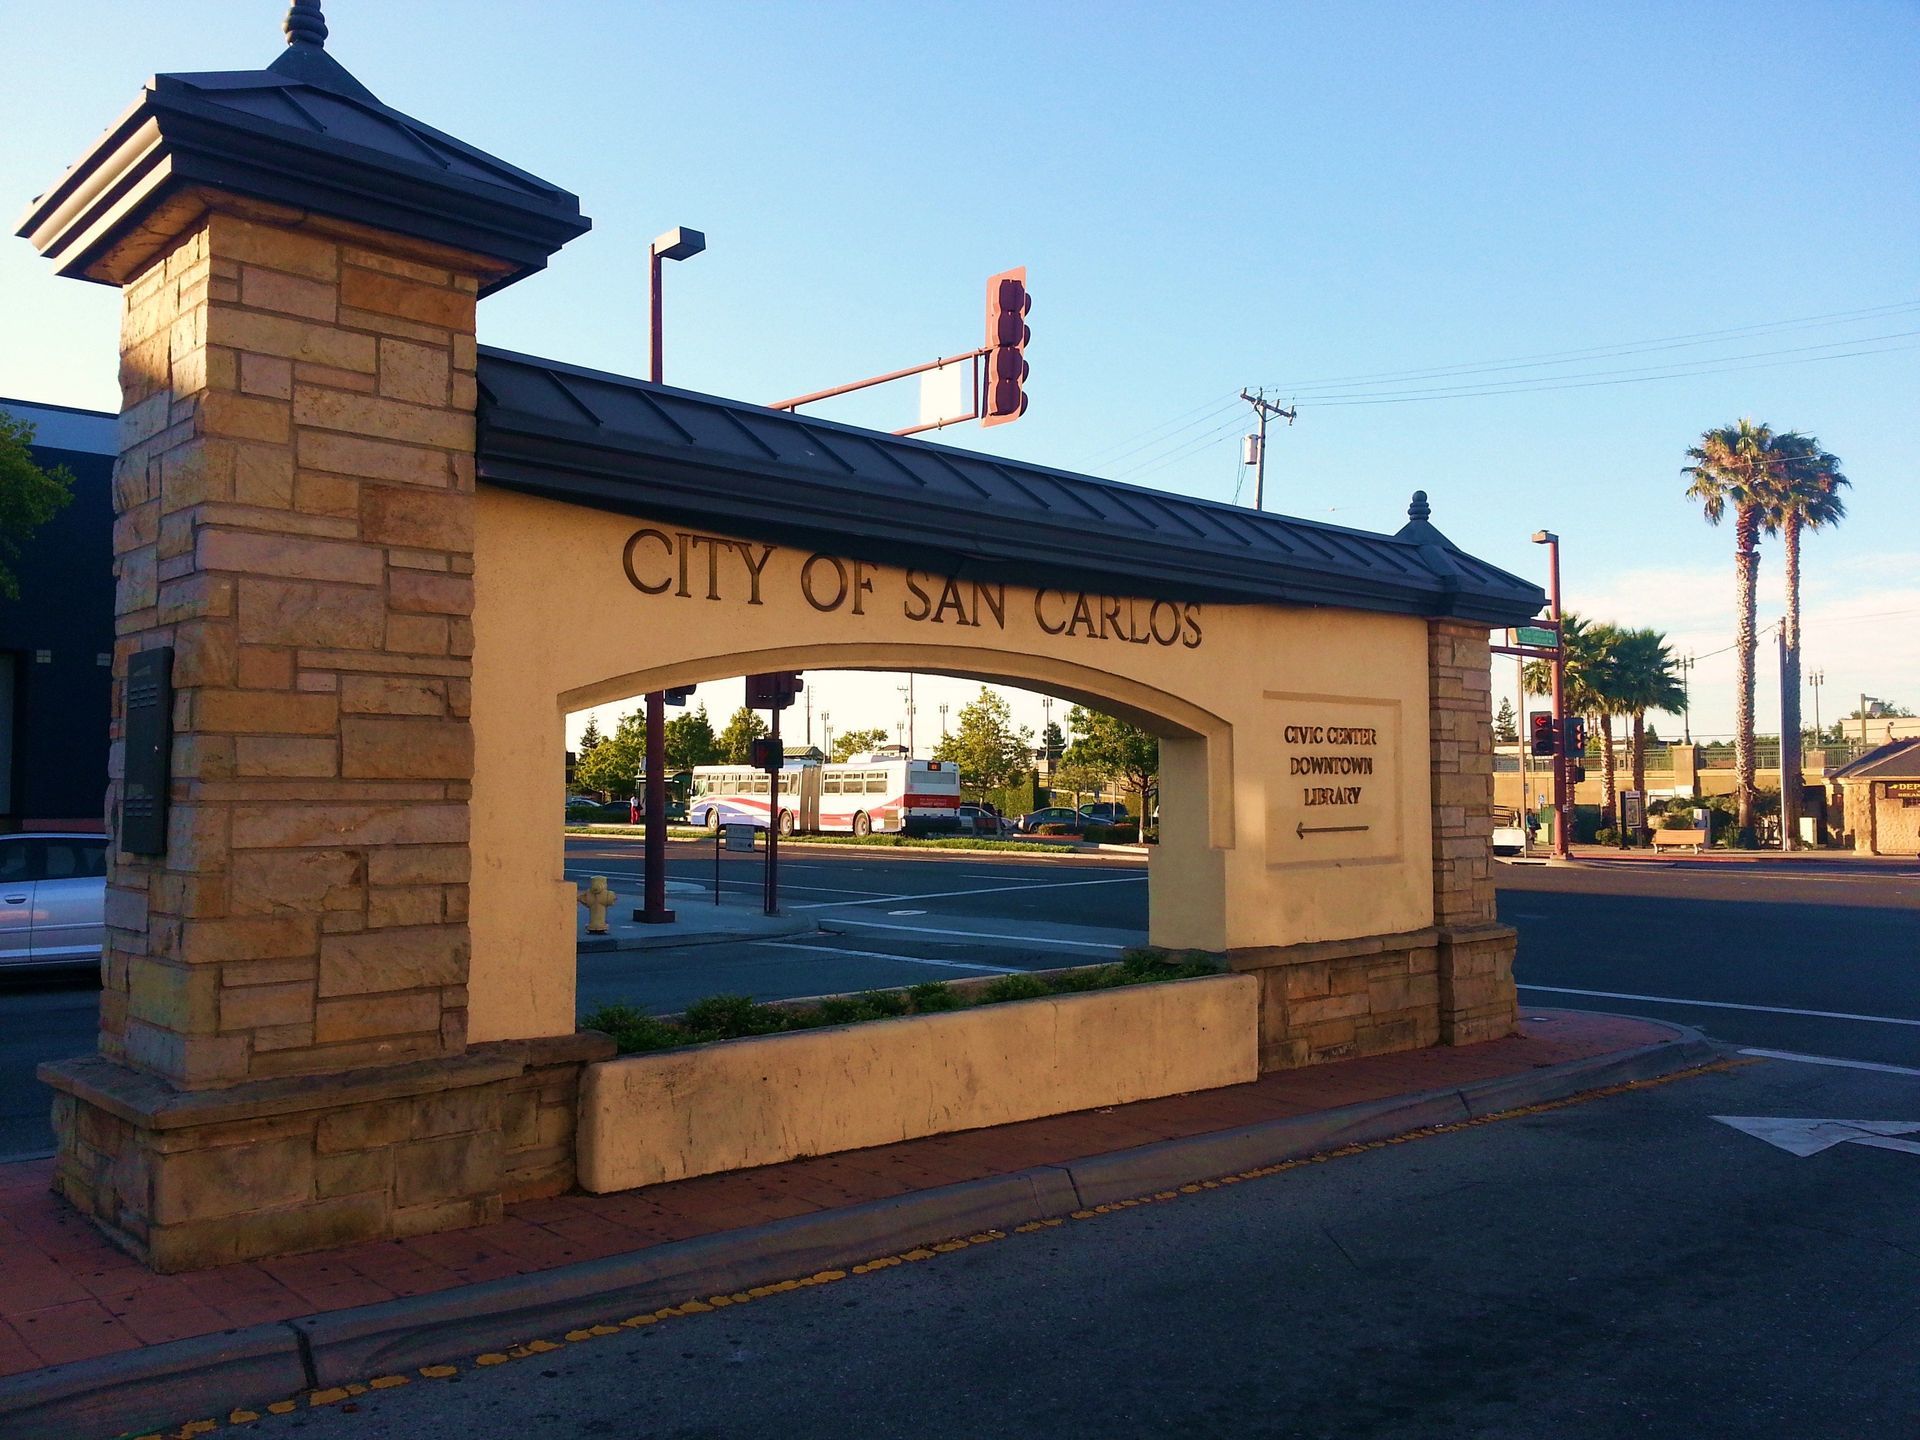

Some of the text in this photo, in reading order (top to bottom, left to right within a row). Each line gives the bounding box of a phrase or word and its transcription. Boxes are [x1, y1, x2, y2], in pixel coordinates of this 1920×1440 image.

[622, 528, 1203, 650] CITY OF SAN CARLOS
[1284, 725, 1377, 745] CIVIC CENTER
[1290, 757, 1373, 775] DOWNTOWN
[1304, 786, 1362, 806] LIBRARY
